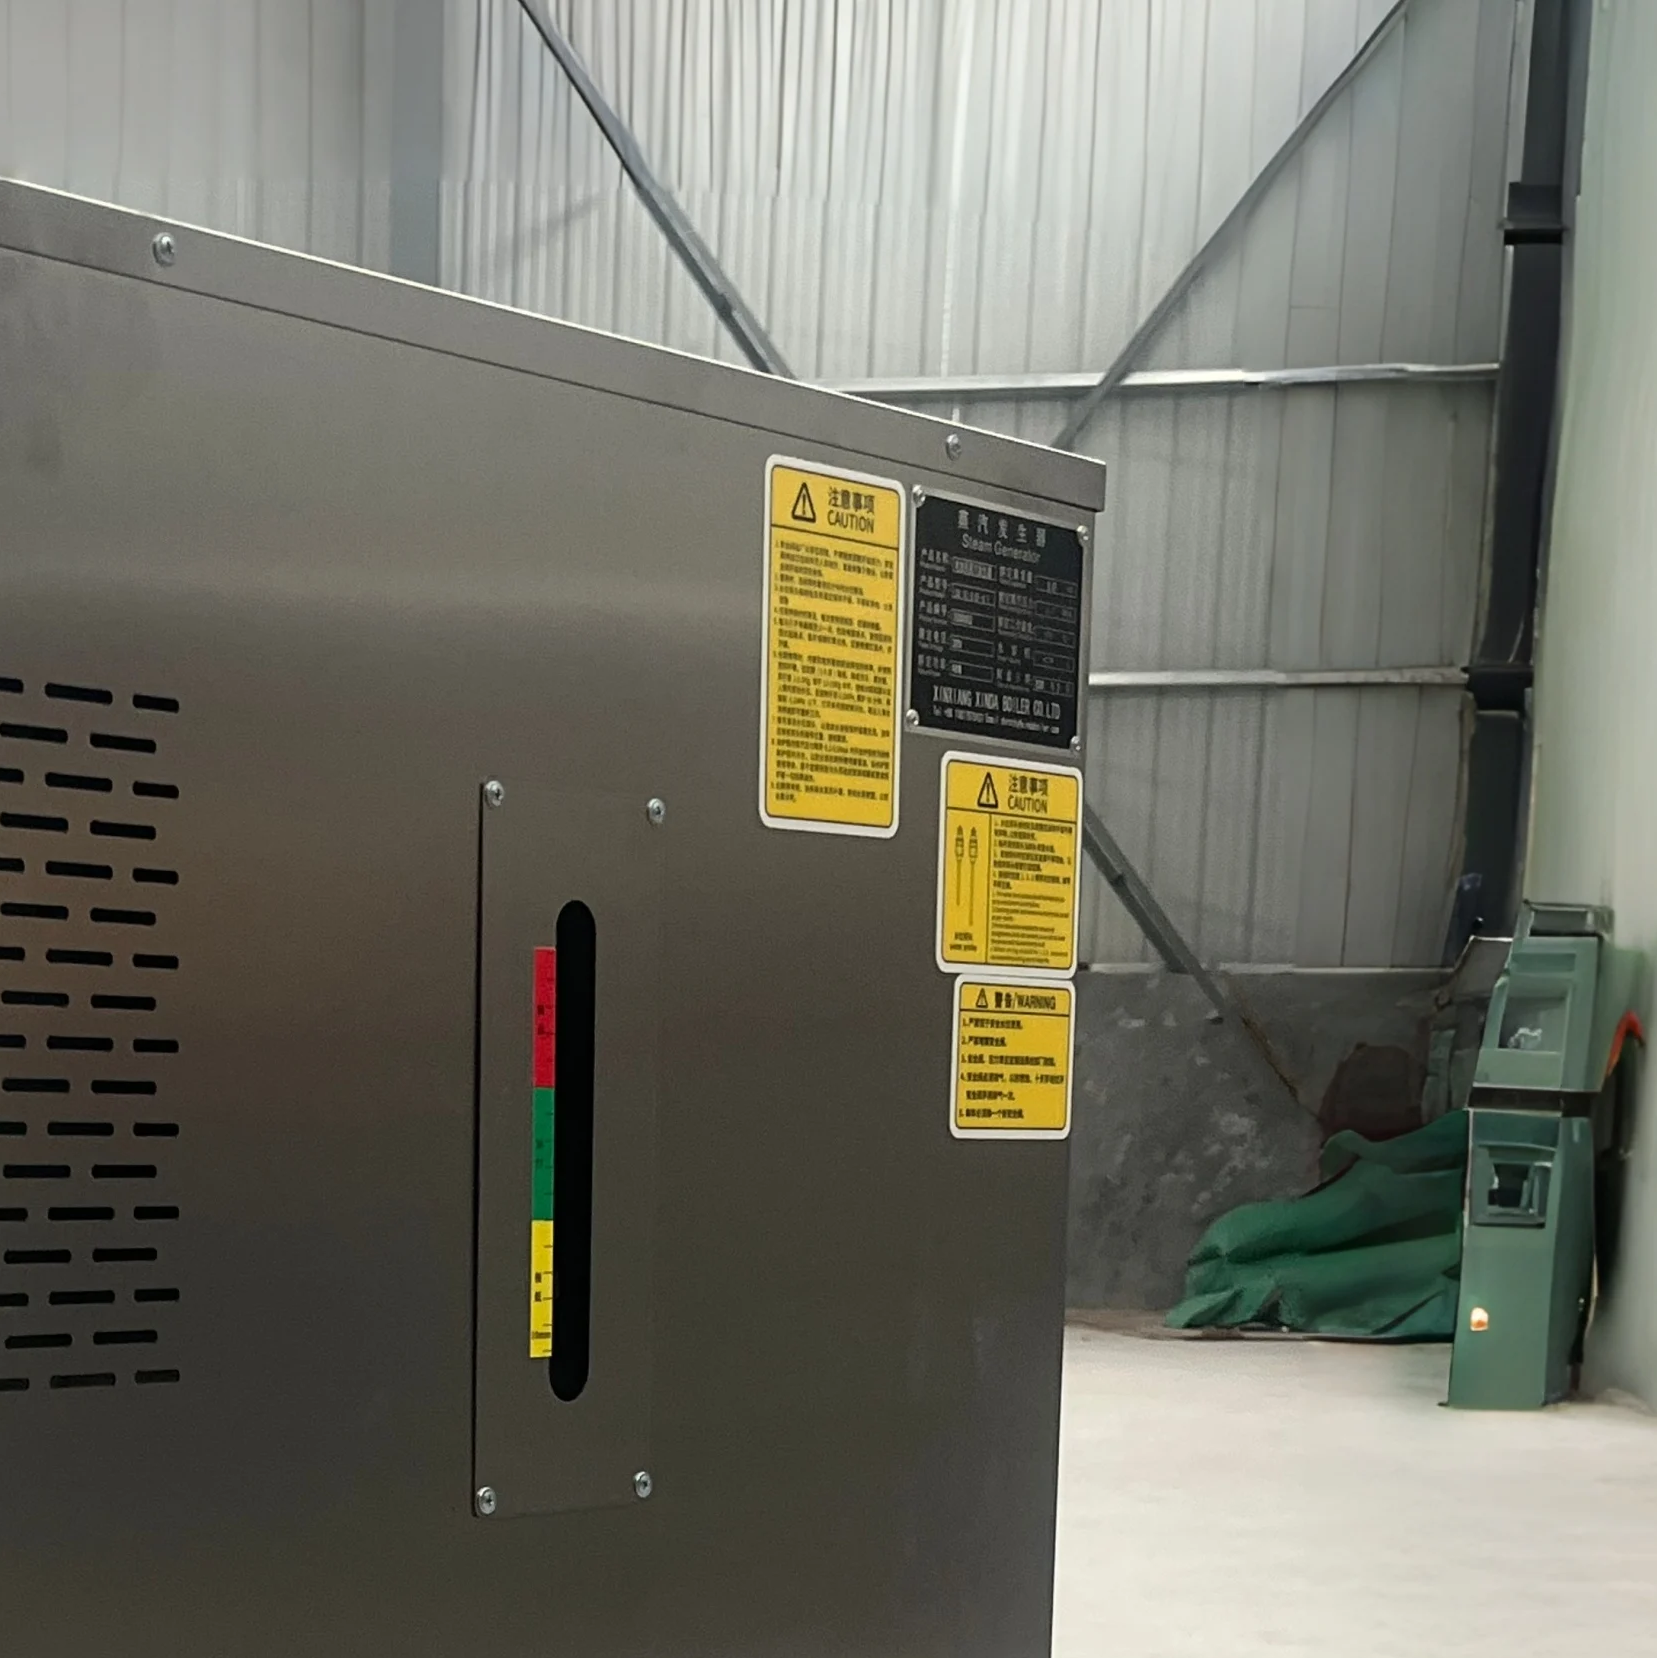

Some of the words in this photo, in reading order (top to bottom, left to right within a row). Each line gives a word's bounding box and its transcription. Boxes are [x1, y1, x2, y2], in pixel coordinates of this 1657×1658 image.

[827, 486, 875, 514] 注意事项
[827, 509, 875, 534] CAUTION
[962, 533, 993, 553] Steam
[1008, 794, 1048, 814] CAUTION
